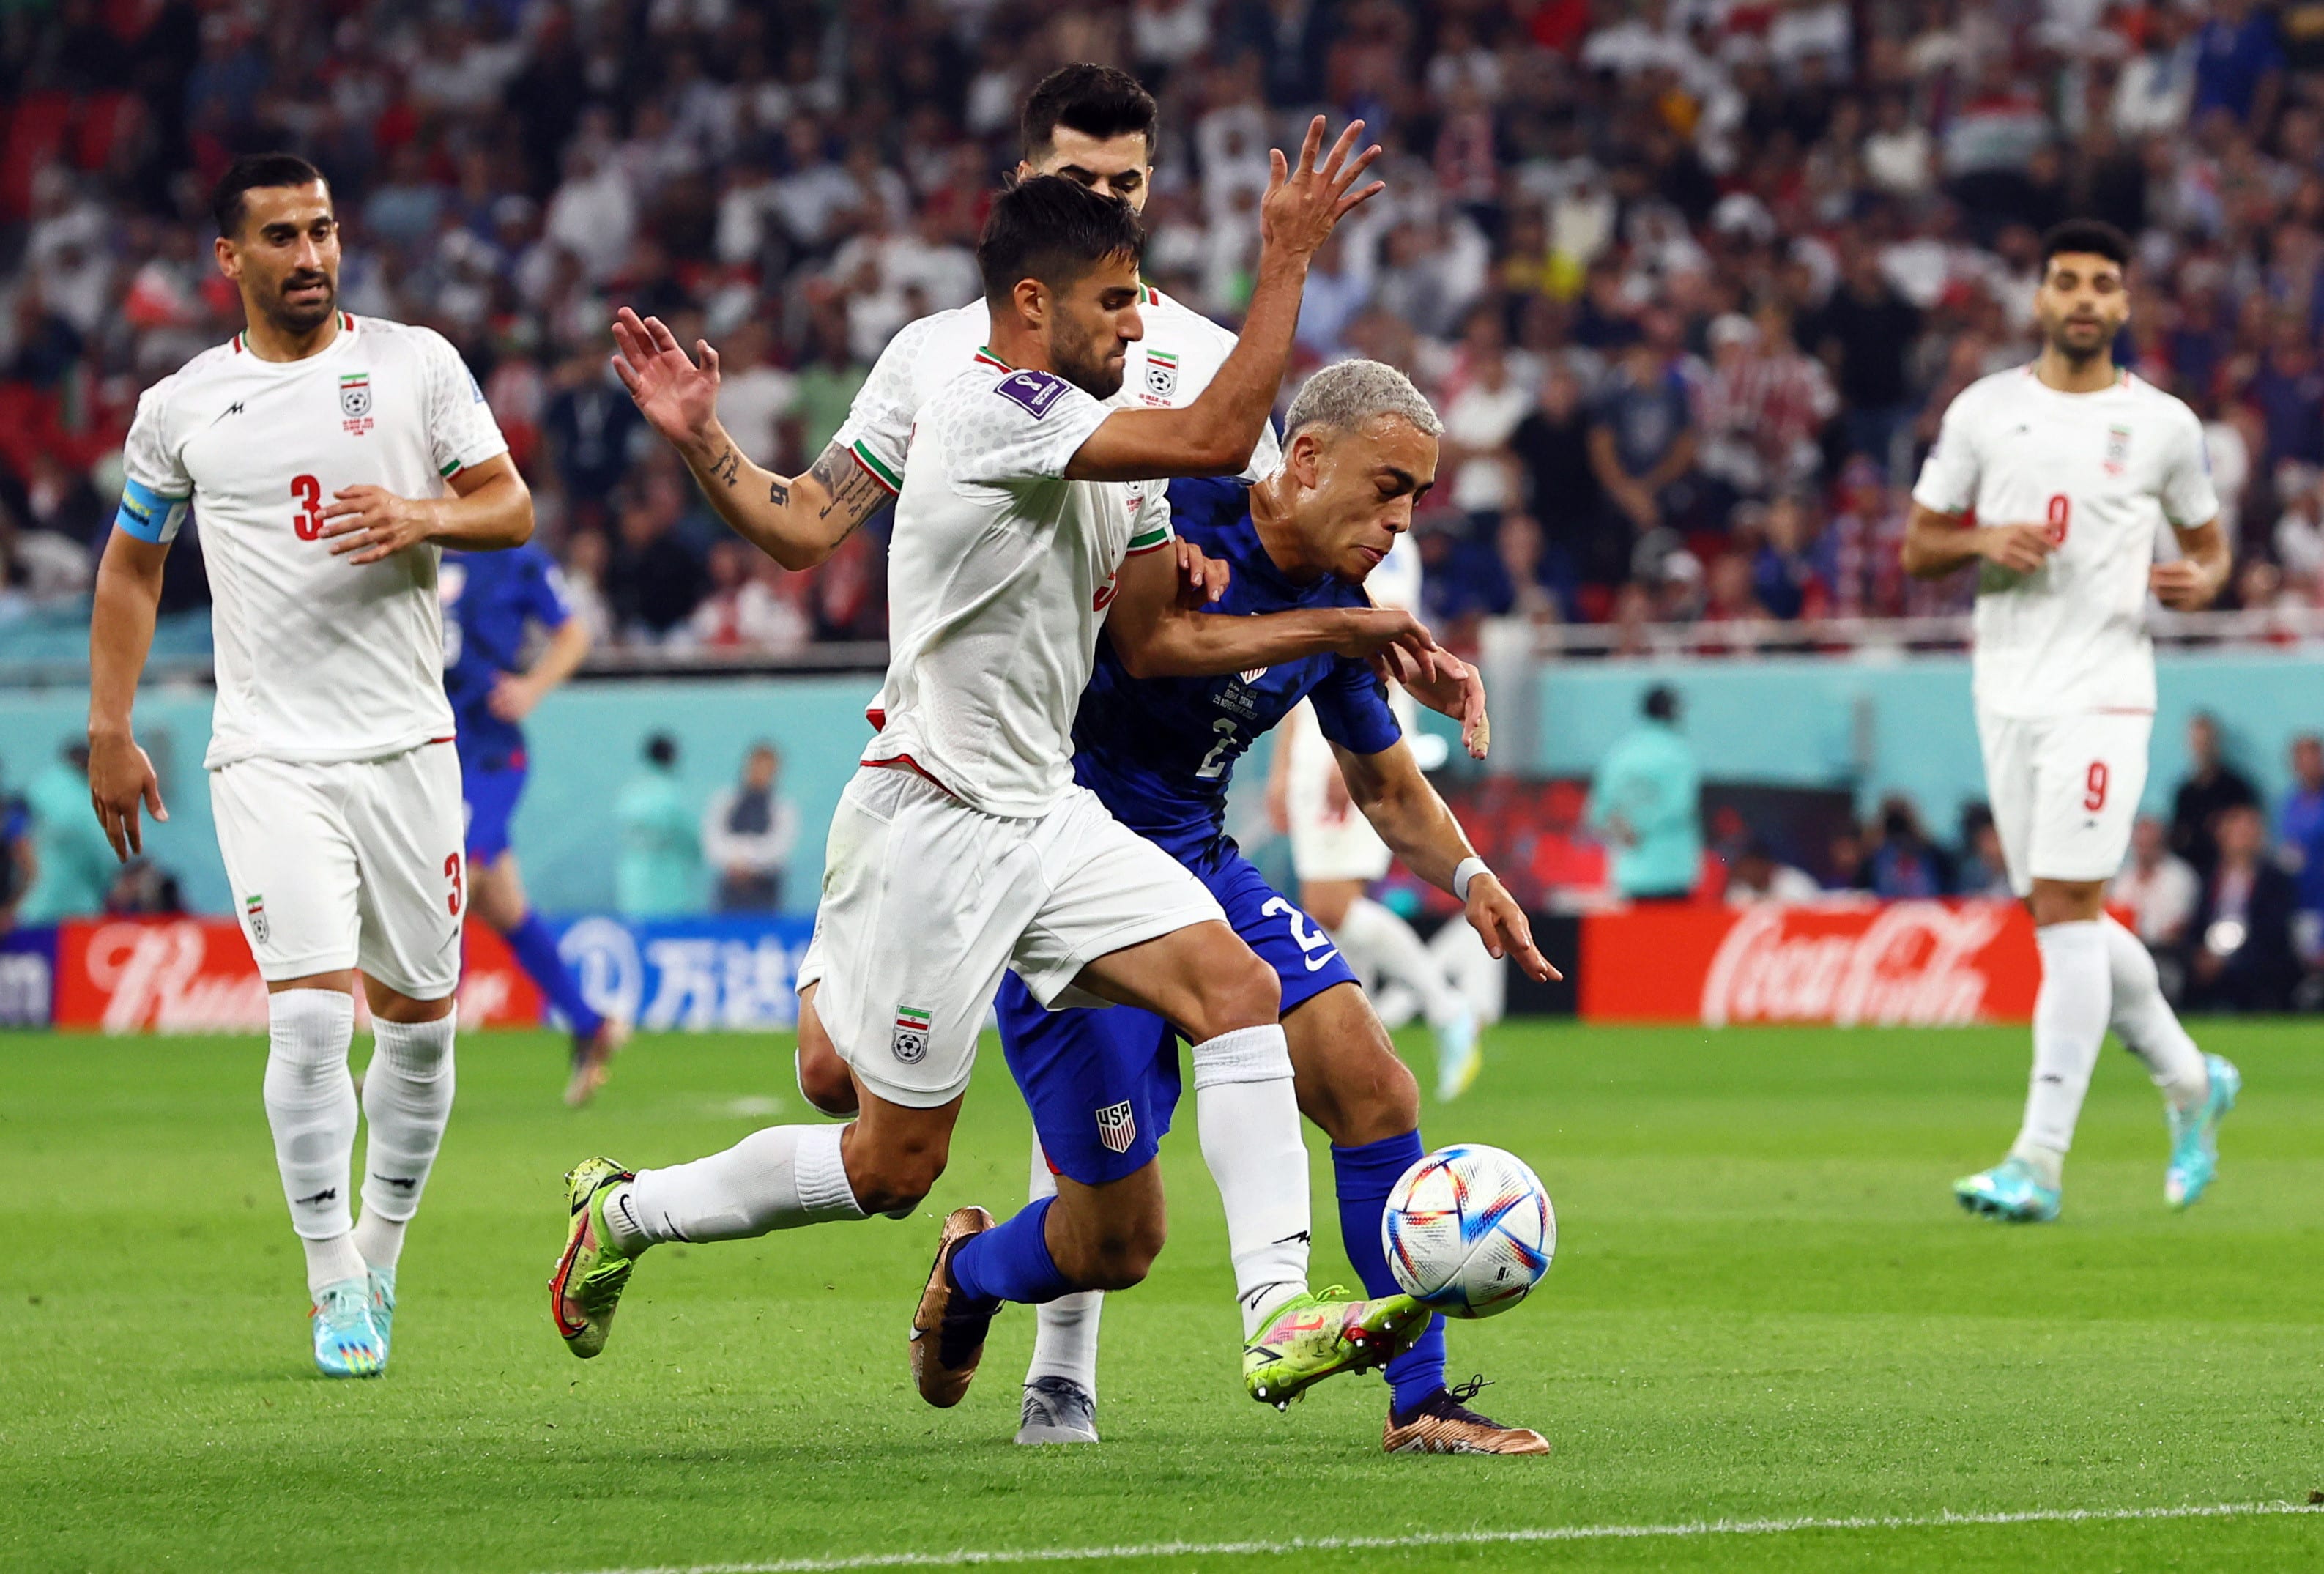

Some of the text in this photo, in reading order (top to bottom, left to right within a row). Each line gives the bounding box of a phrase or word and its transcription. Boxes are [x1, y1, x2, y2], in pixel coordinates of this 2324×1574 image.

[291, 475, 324, 541] 3
[1195, 718, 1238, 777] 2
[2084, 762, 2107, 811] 9
[444, 852, 461, 916] 3
[1261, 896, 1330, 952] 2
[1097, 1102, 1130, 1126] USA
